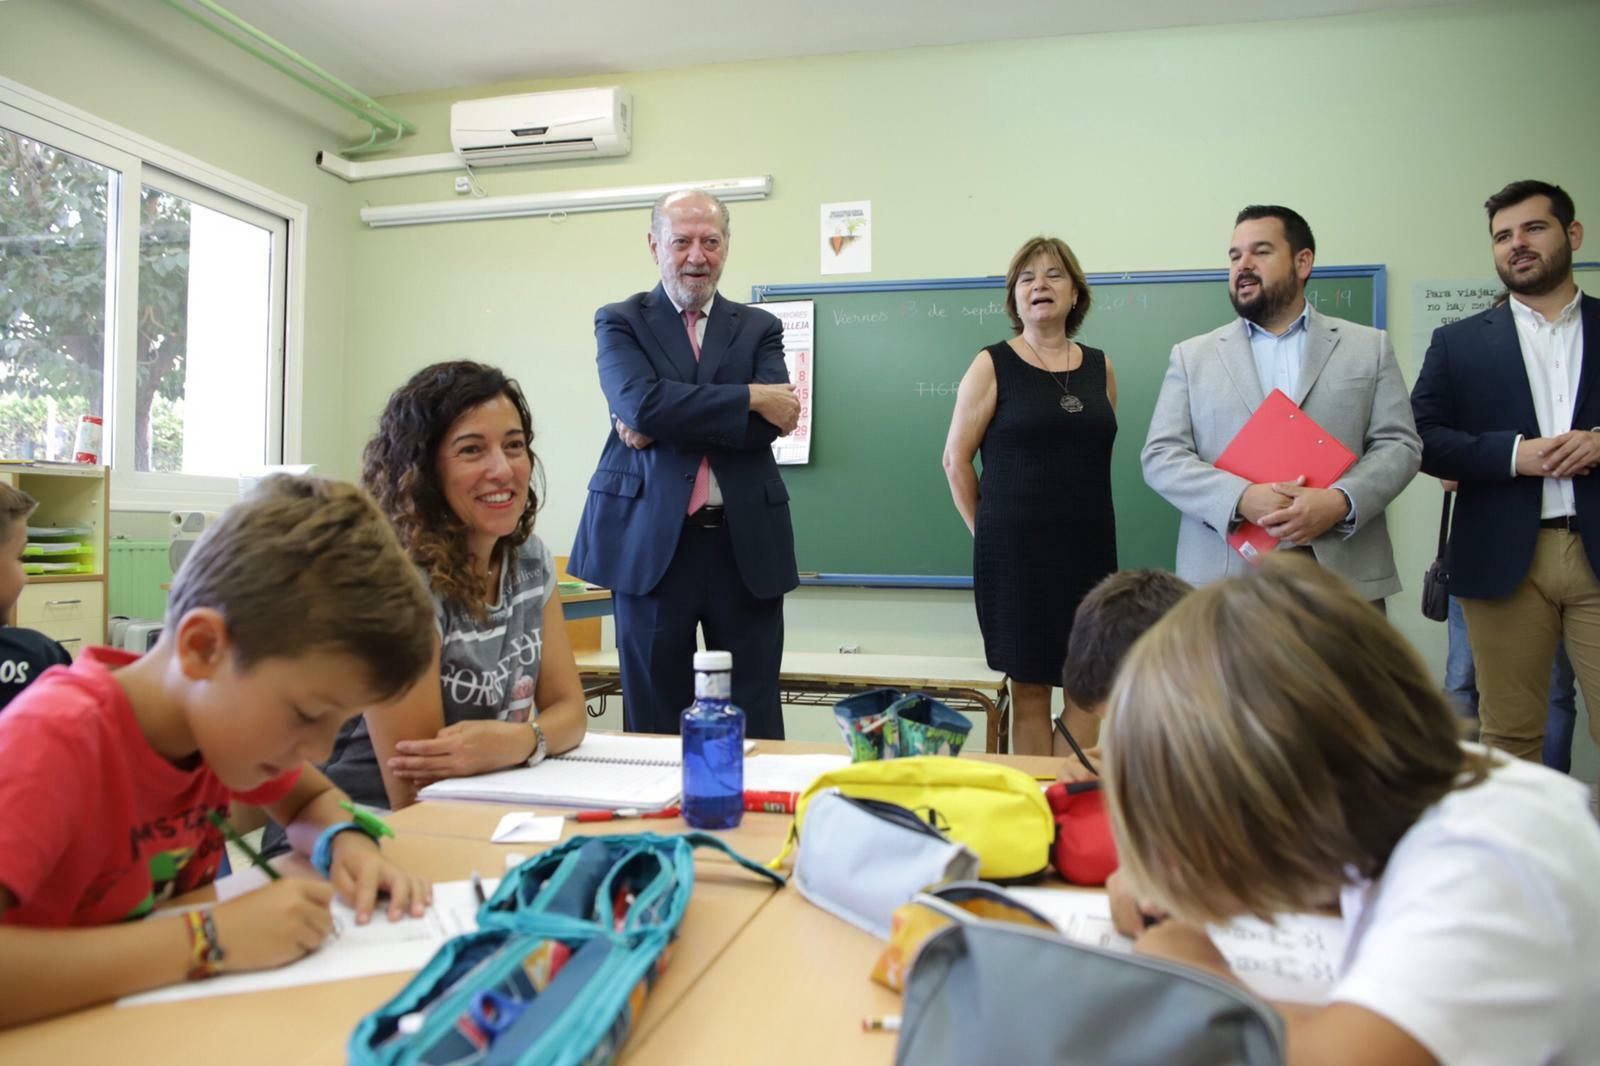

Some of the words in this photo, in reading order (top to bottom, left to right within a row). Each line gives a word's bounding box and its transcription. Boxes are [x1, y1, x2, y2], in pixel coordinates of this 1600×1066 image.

[1425, 289, 1452, 299] Para
[1456, 288, 1497, 299] viajar
[1426, 303, 1441, 312] no
[1446, 302, 1465, 313] hay
[833, 309, 889, 327] Viernes
[927, 303, 948, 318] de
